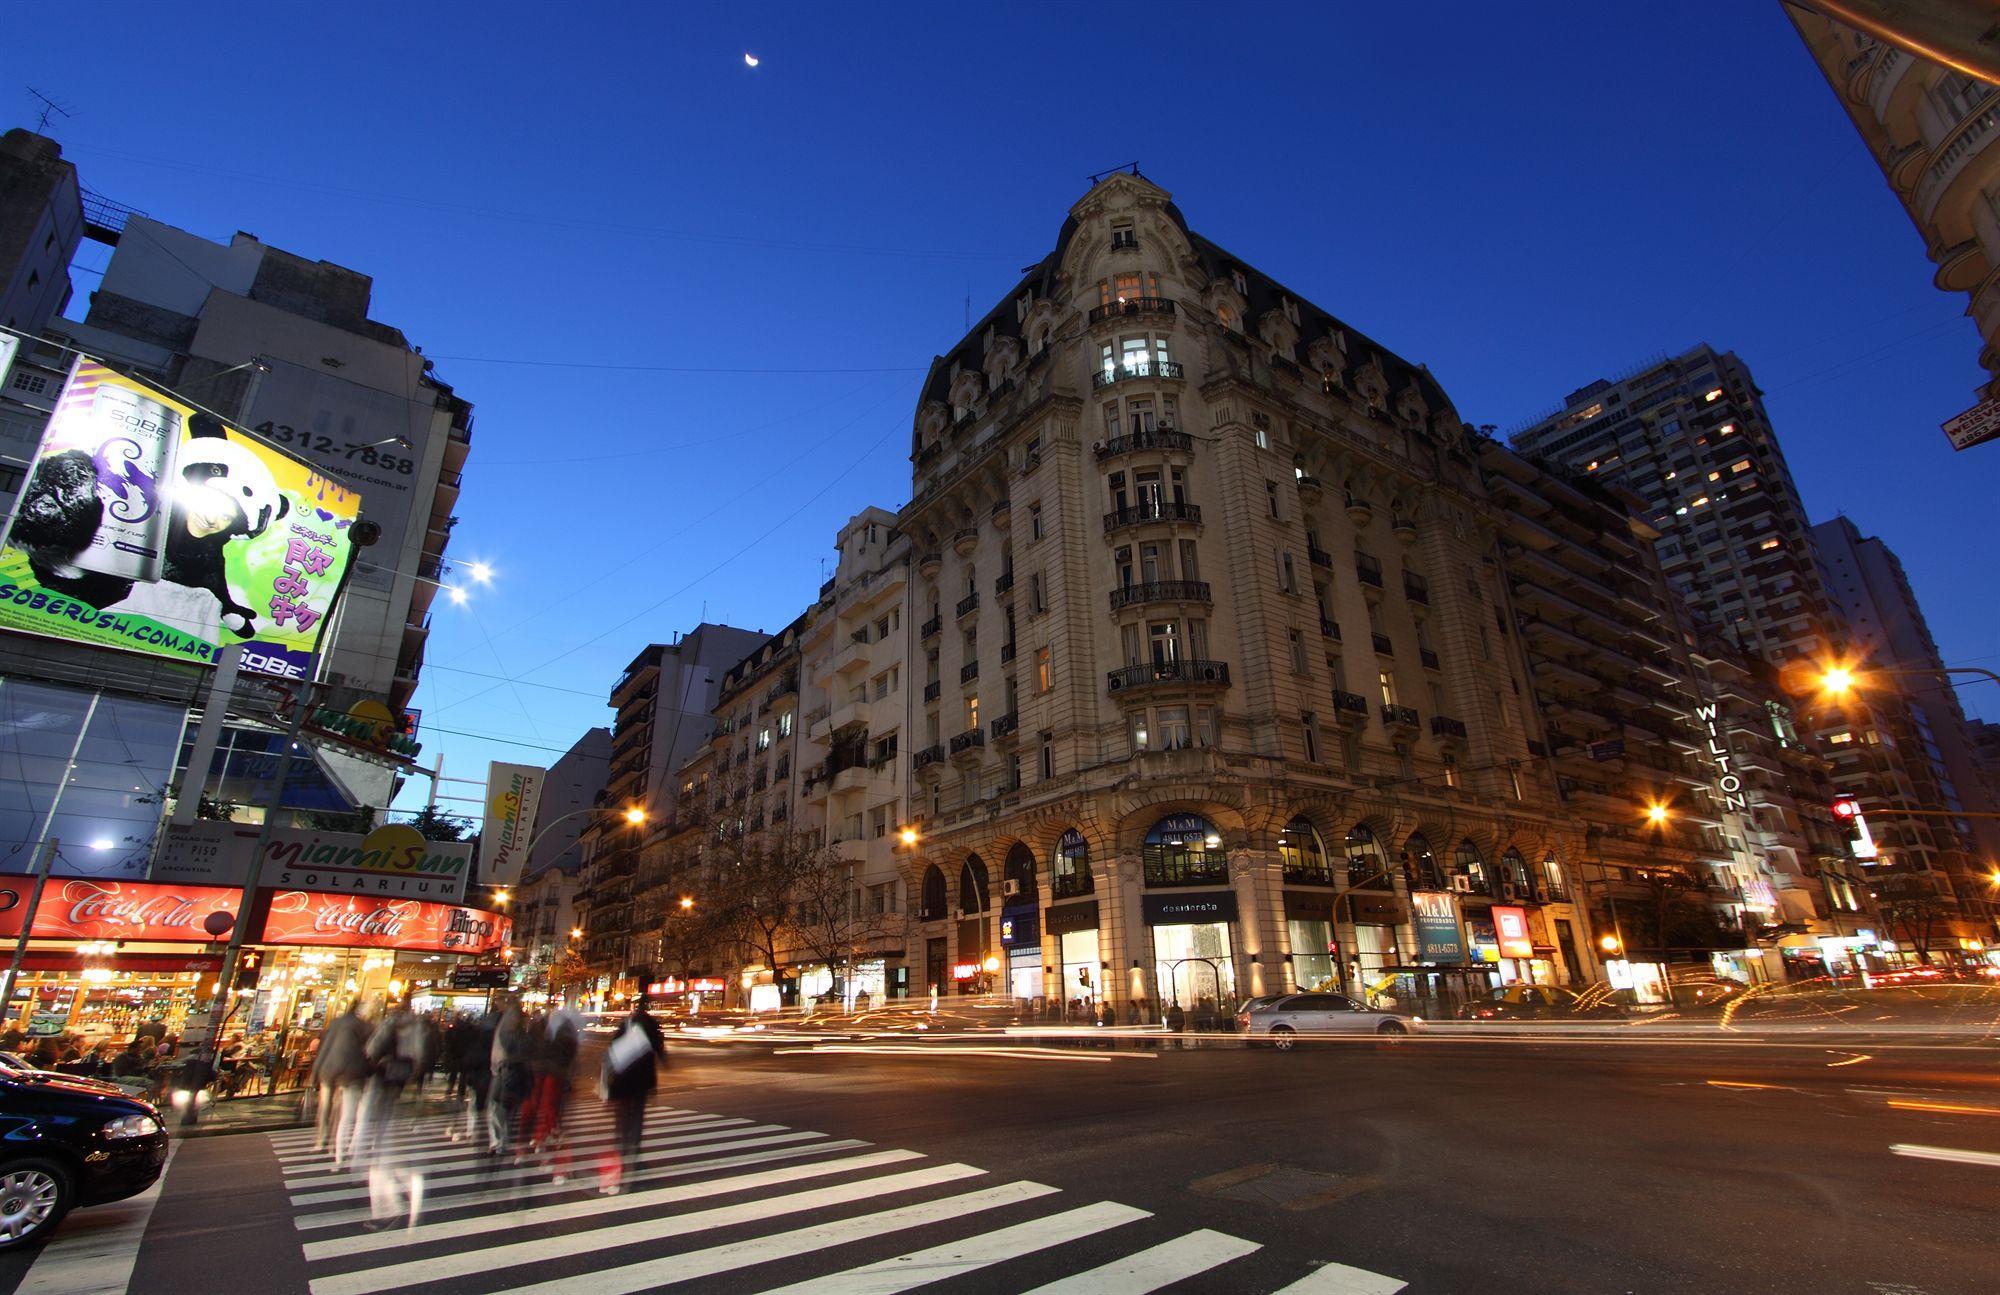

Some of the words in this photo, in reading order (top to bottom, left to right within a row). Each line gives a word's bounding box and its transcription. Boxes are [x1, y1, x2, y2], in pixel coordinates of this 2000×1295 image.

[110, 408, 167, 438] SOBE
[254, 420, 414, 476] 4312-7858
[269, 537, 335, 634] 飲み物
[0, 584, 214, 660] SOBERUSH.COM.AR
[1695, 703, 1747, 811] WILTON
[491, 772, 523, 874] MiamiSun
[515, 777, 534, 852] SOLARIUM
[1185, 818, 1195, 828] M
[160, 865, 213, 873] ARGENTINA
[190, 845, 218, 857] PISO
[264, 838, 465, 877] MiamiSun
[281, 872, 455, 894] SOLARIUM
[1162, 903, 1218, 913] desiderata
